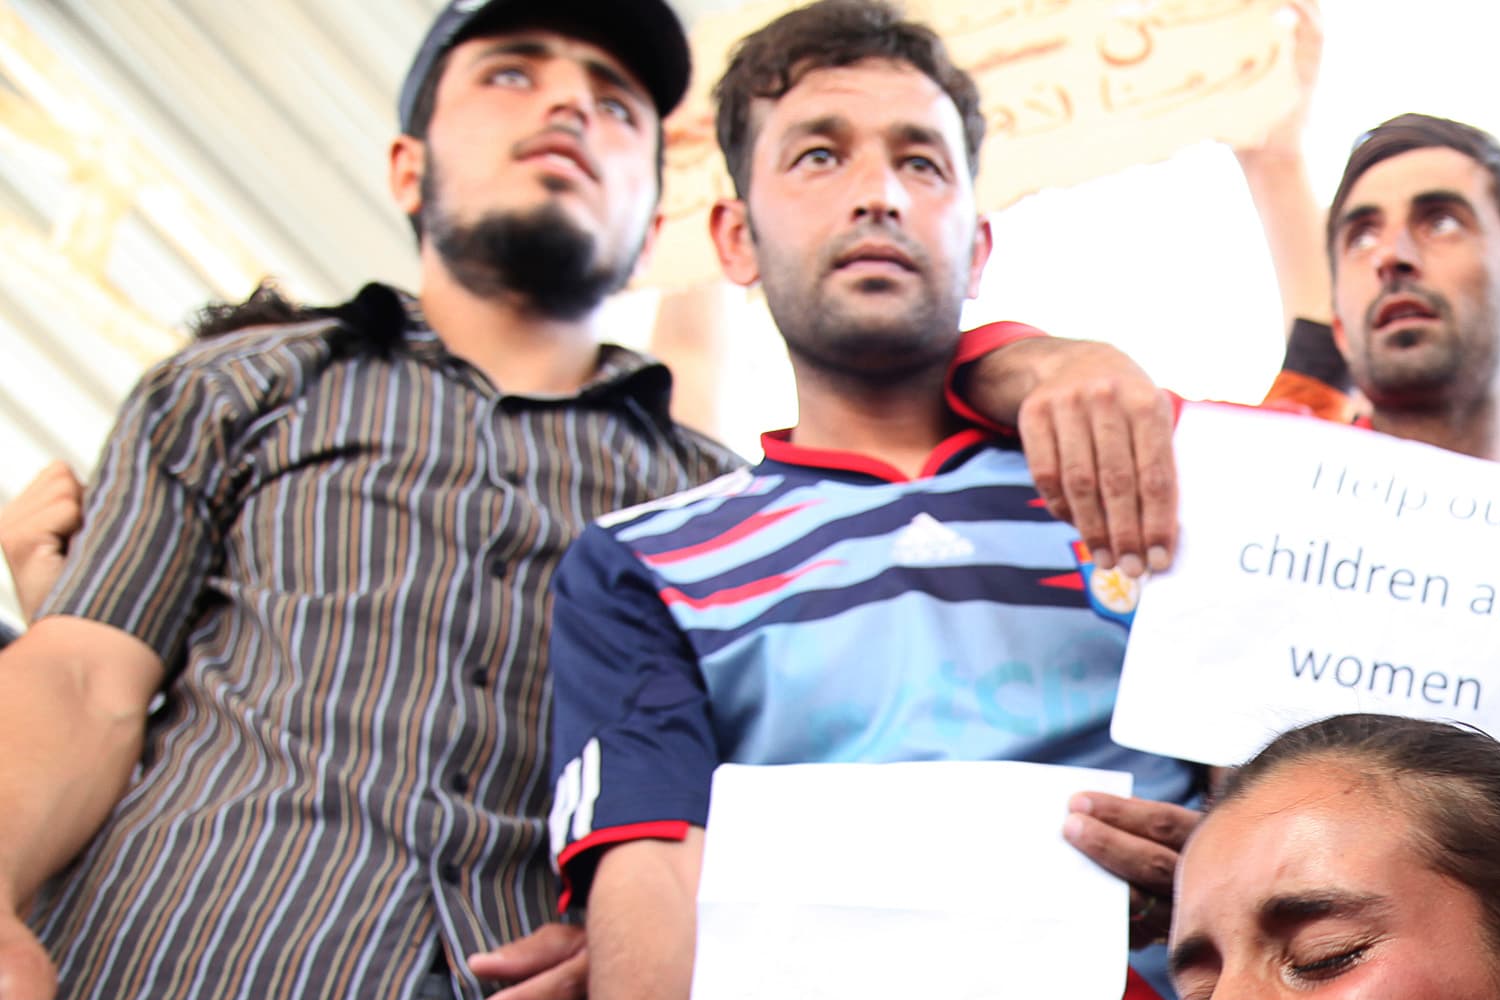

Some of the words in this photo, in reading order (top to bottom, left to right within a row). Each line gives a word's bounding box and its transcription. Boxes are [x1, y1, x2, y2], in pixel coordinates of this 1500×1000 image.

[1311, 460, 1428, 519] Help
[1238, 535, 1449, 608] children
[1288, 644, 1482, 711] women
